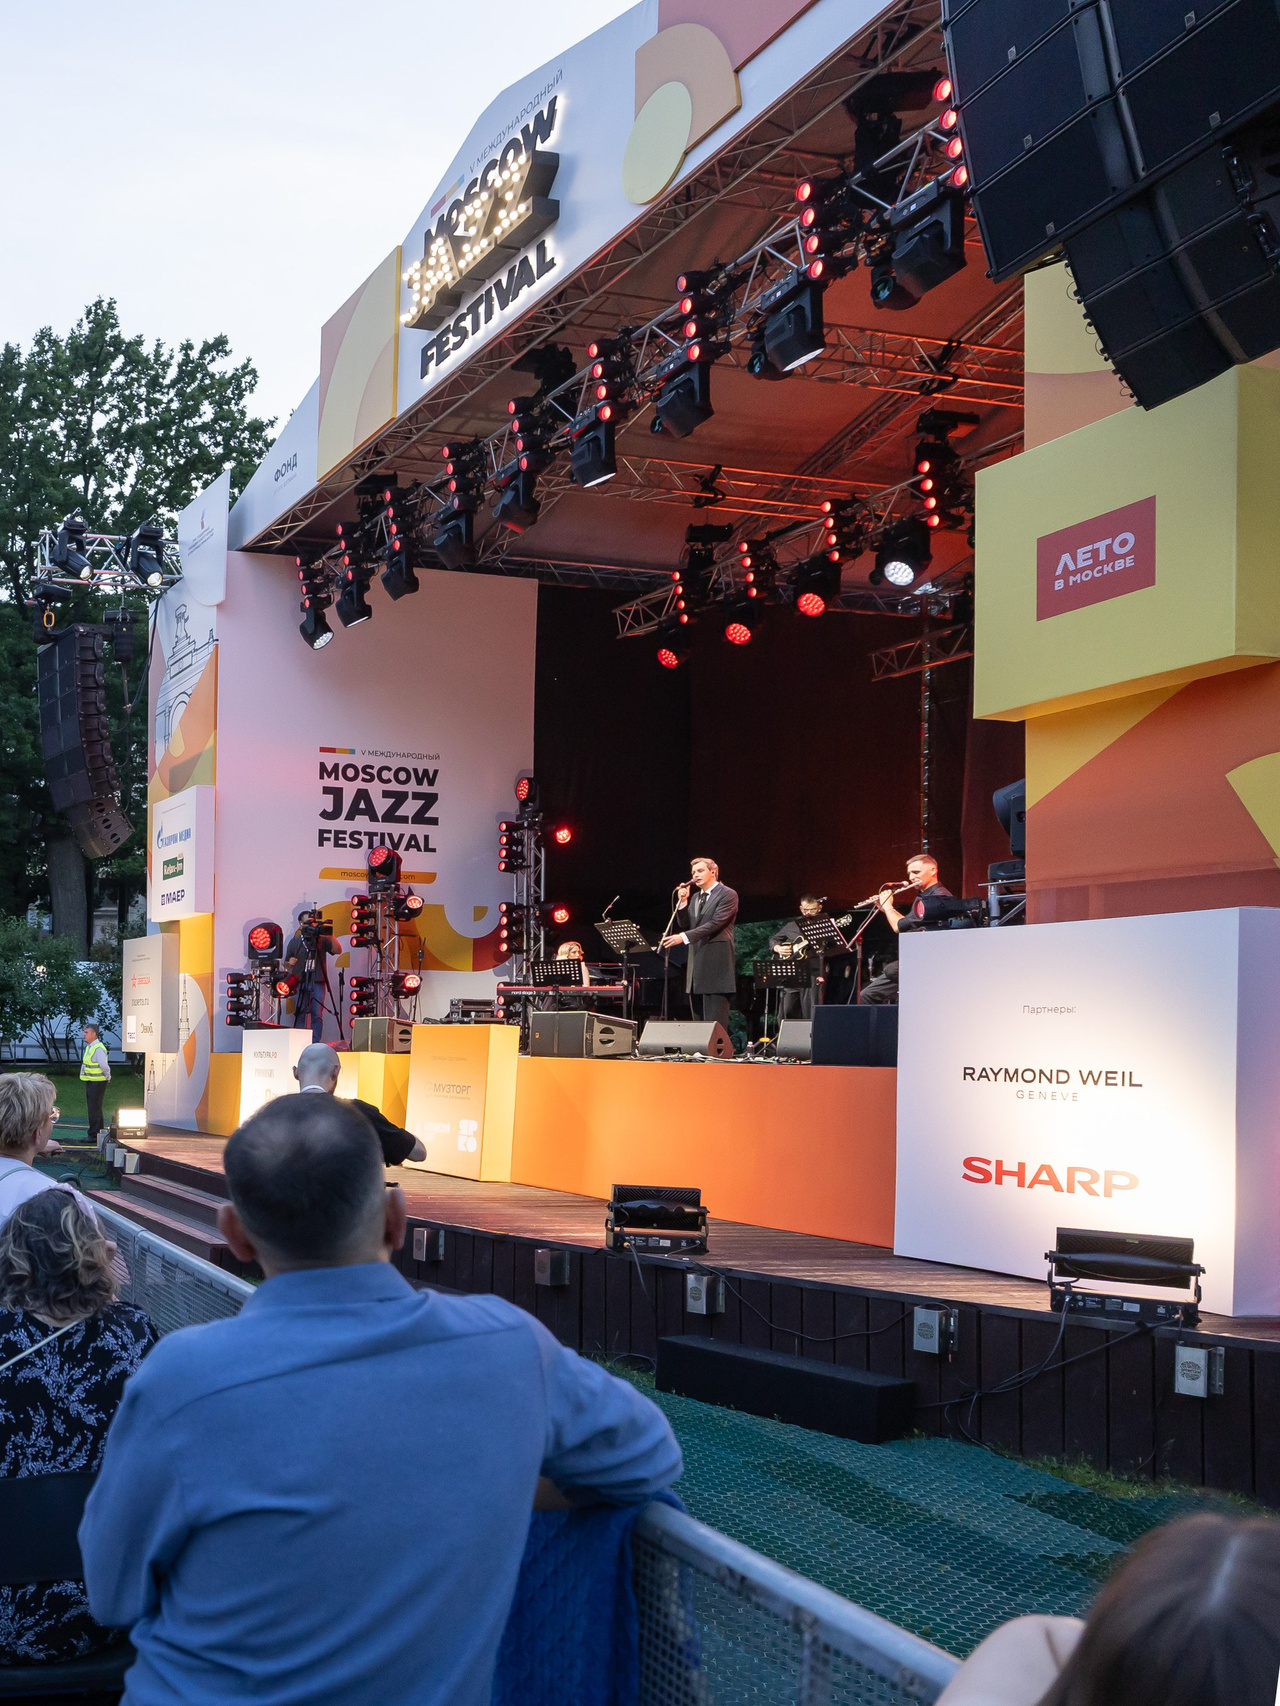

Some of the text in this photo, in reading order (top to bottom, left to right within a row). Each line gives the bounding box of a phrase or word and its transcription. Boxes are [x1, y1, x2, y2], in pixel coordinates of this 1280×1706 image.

[476, 68, 564, 166] МЕЖДУНАРОДНЫЙ
[420, 239, 557, 380] FESTIVAL
[274, 452, 297, 482] ФОНД
[1055, 532, 1135, 576] ЛЕТО
[1054, 555, 1135, 591] В МОСКВЕ
[368, 750, 440, 760] МЕЖДУНАРОДНЫЙ
[319, 762, 440, 787] MOSCOW
[319, 786, 439, 826] JAZZ
[318, 828, 437, 853] FESTIVAL
[1022, 1004, 1077, 1015] Партнеры:
[433, 1083, 472, 1095] МУЗТОРГ
[963, 1066, 1143, 1088] RAYMOND WEIL
[1016, 1090, 1079, 1102] GENEVE
[961, 1156, 1140, 1198] SHARP
